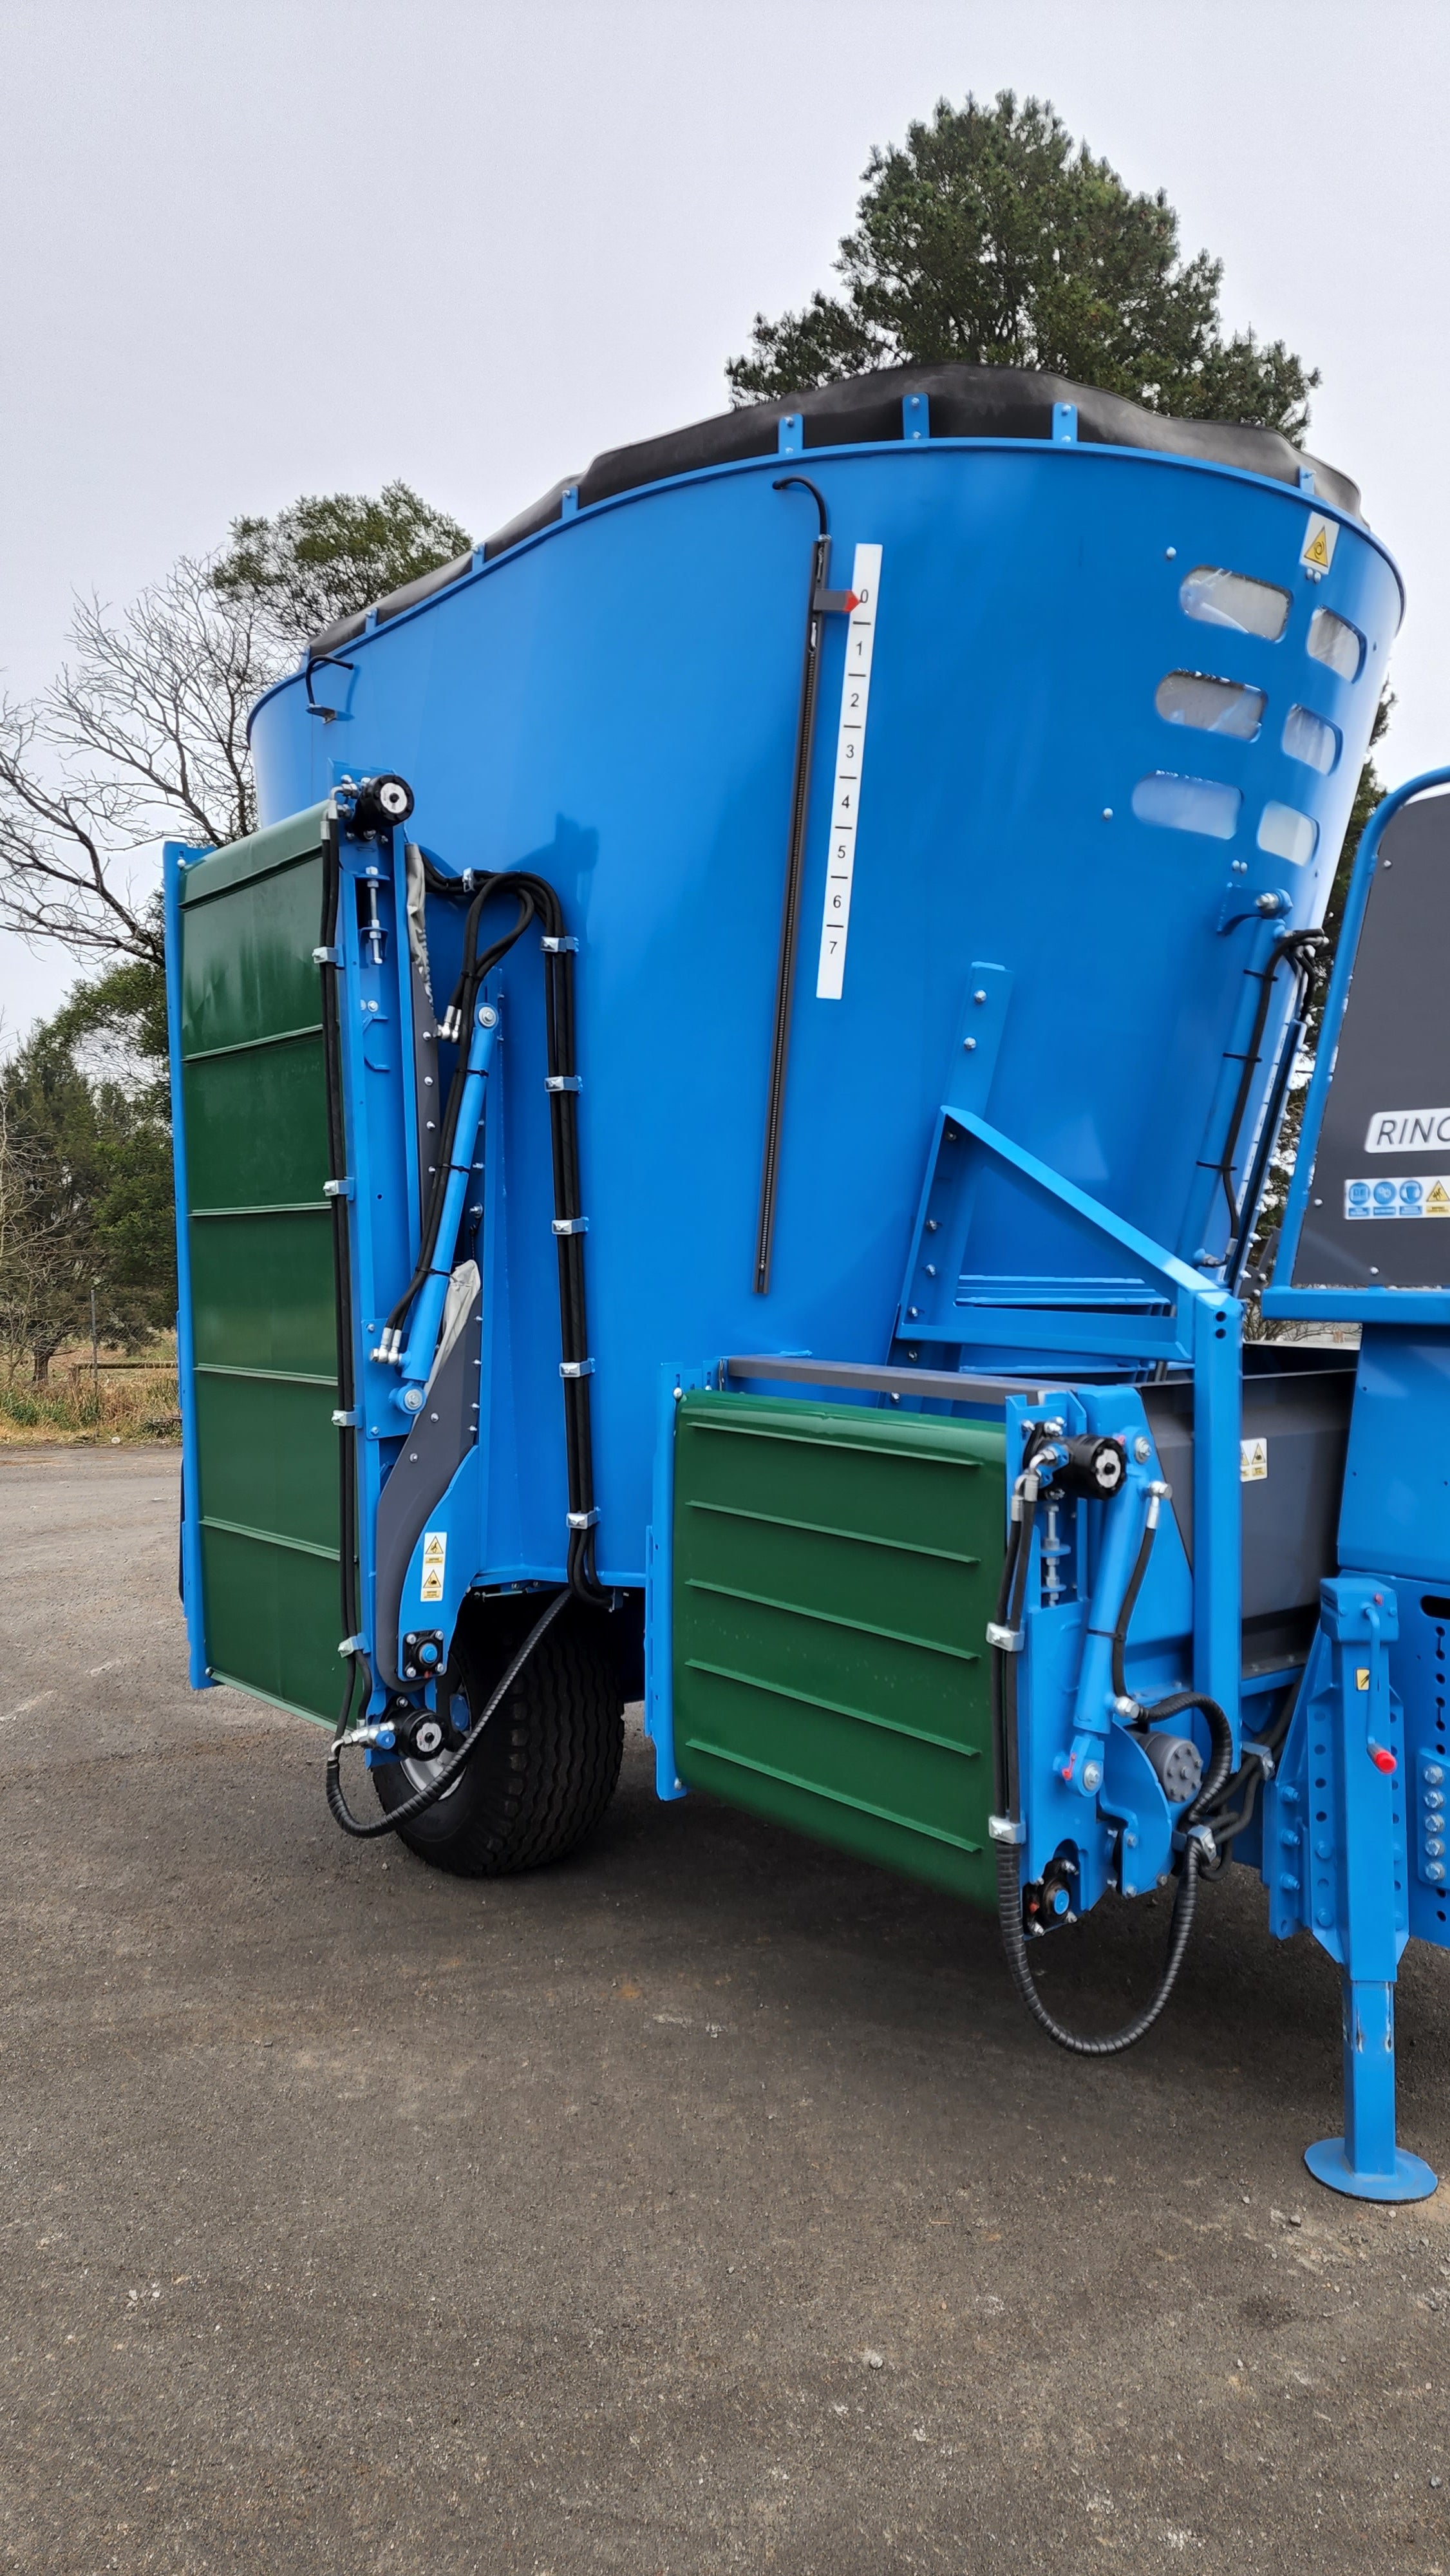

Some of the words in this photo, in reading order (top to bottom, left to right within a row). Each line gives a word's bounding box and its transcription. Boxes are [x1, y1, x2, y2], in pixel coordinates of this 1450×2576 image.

[860, 589, 869, 604] 0
[856, 641, 863, 656] 1
[851, 692, 860, 708] 2
[845, 744, 854, 759] 3
[841, 795, 850, 809] 4
[837, 845, 846, 859] 5
[833, 895, 842, 909] 6
[829, 941, 838, 954] 7
